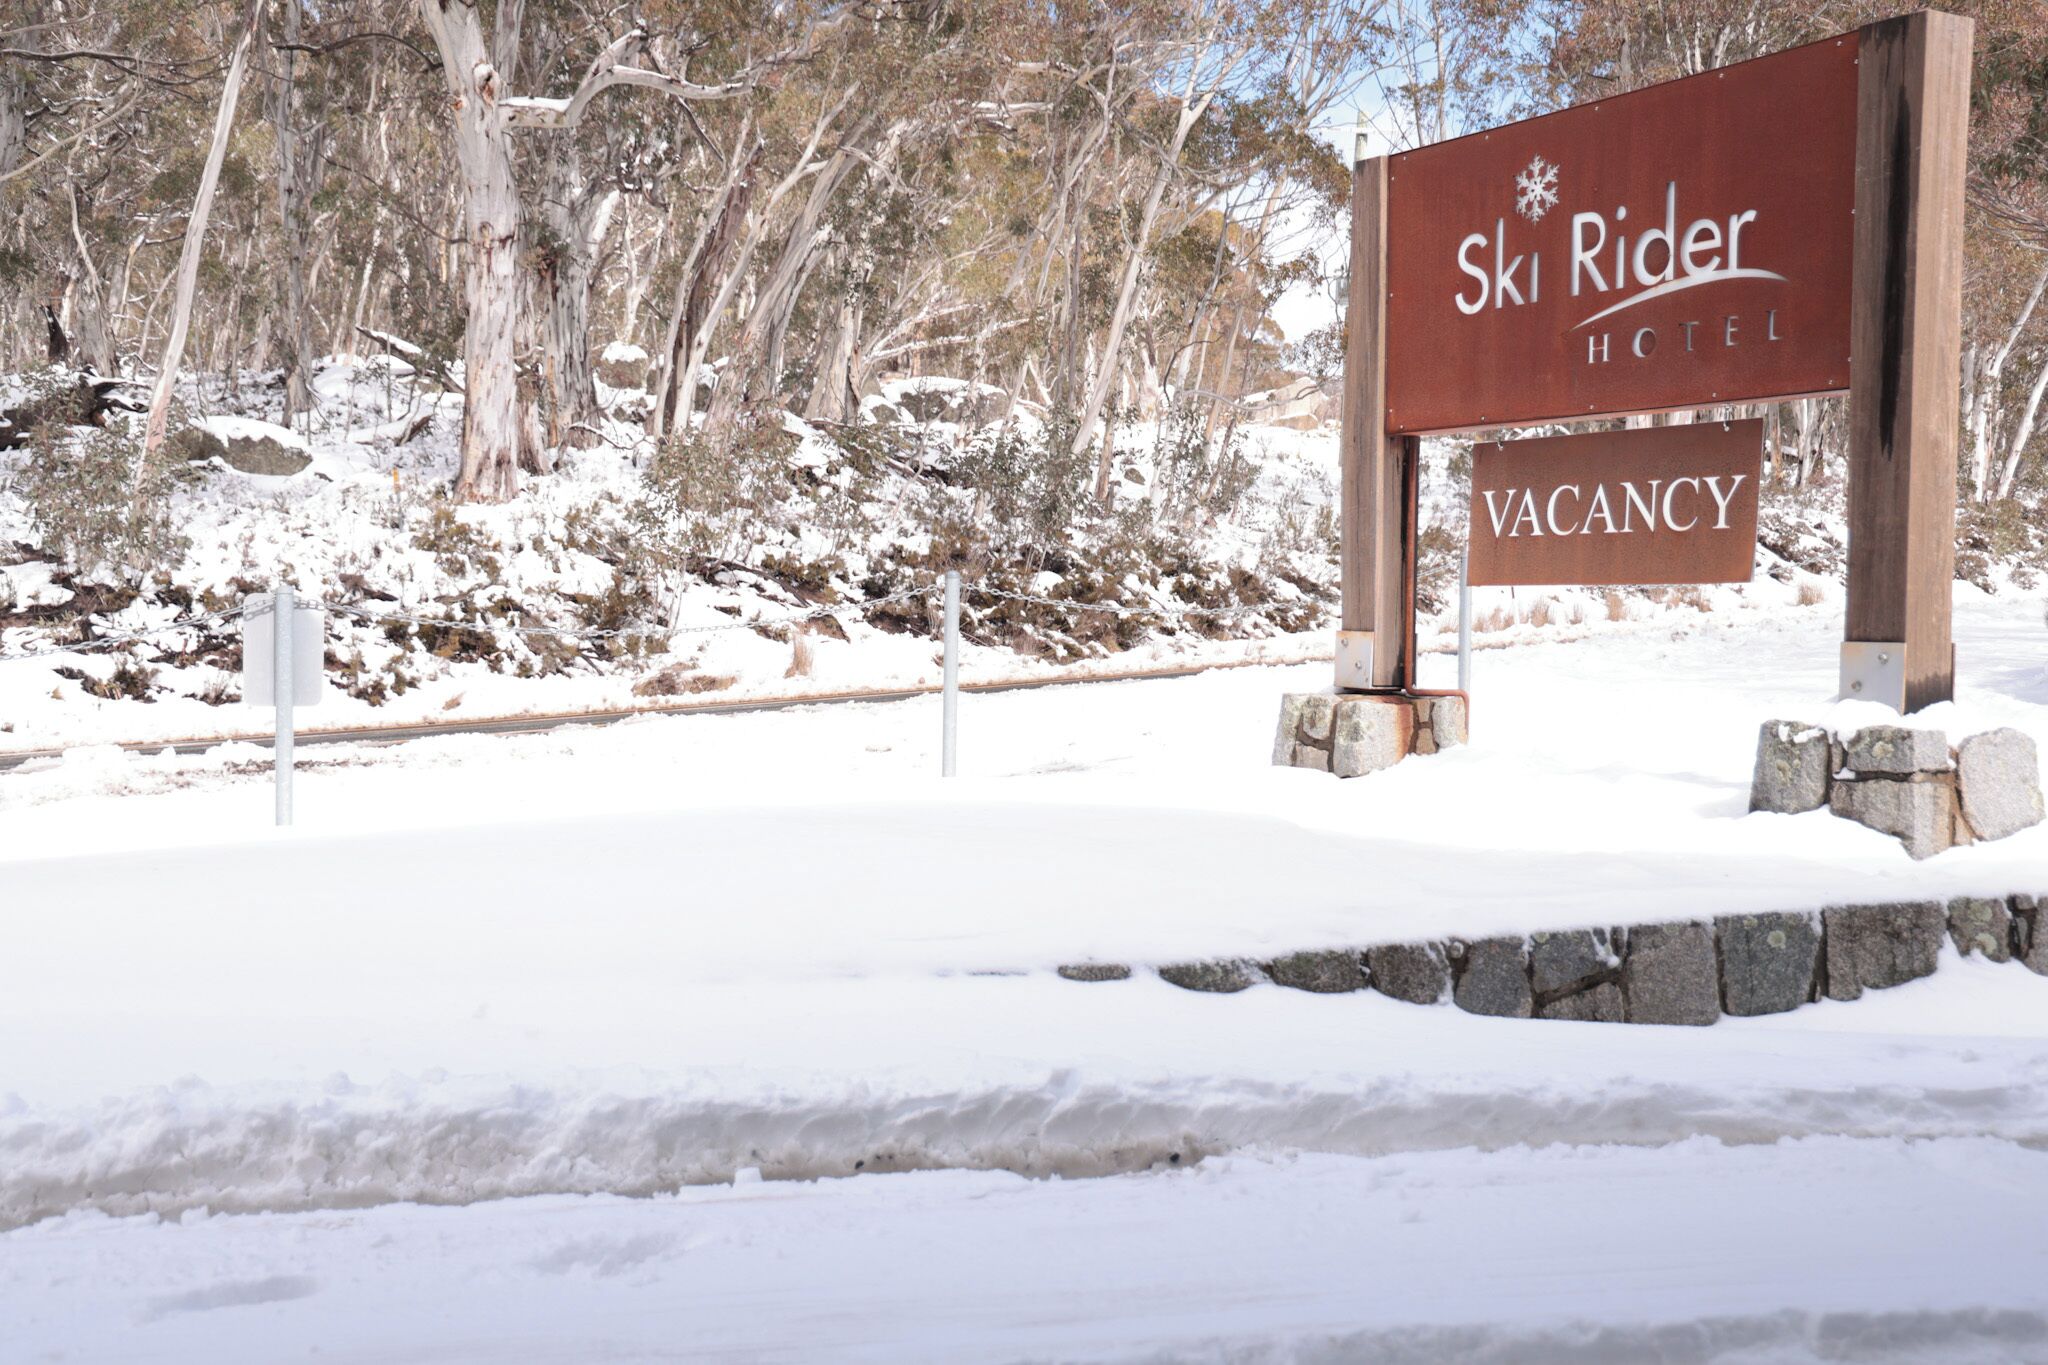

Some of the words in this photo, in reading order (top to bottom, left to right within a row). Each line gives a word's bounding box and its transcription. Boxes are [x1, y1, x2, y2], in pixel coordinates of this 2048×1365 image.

[1455, 217, 1539, 315] Ski
[1570, 181, 1758, 297] Rider
[1587, 308, 1783, 365] HOTEL
[1482, 474, 1747, 538] VACANCY
